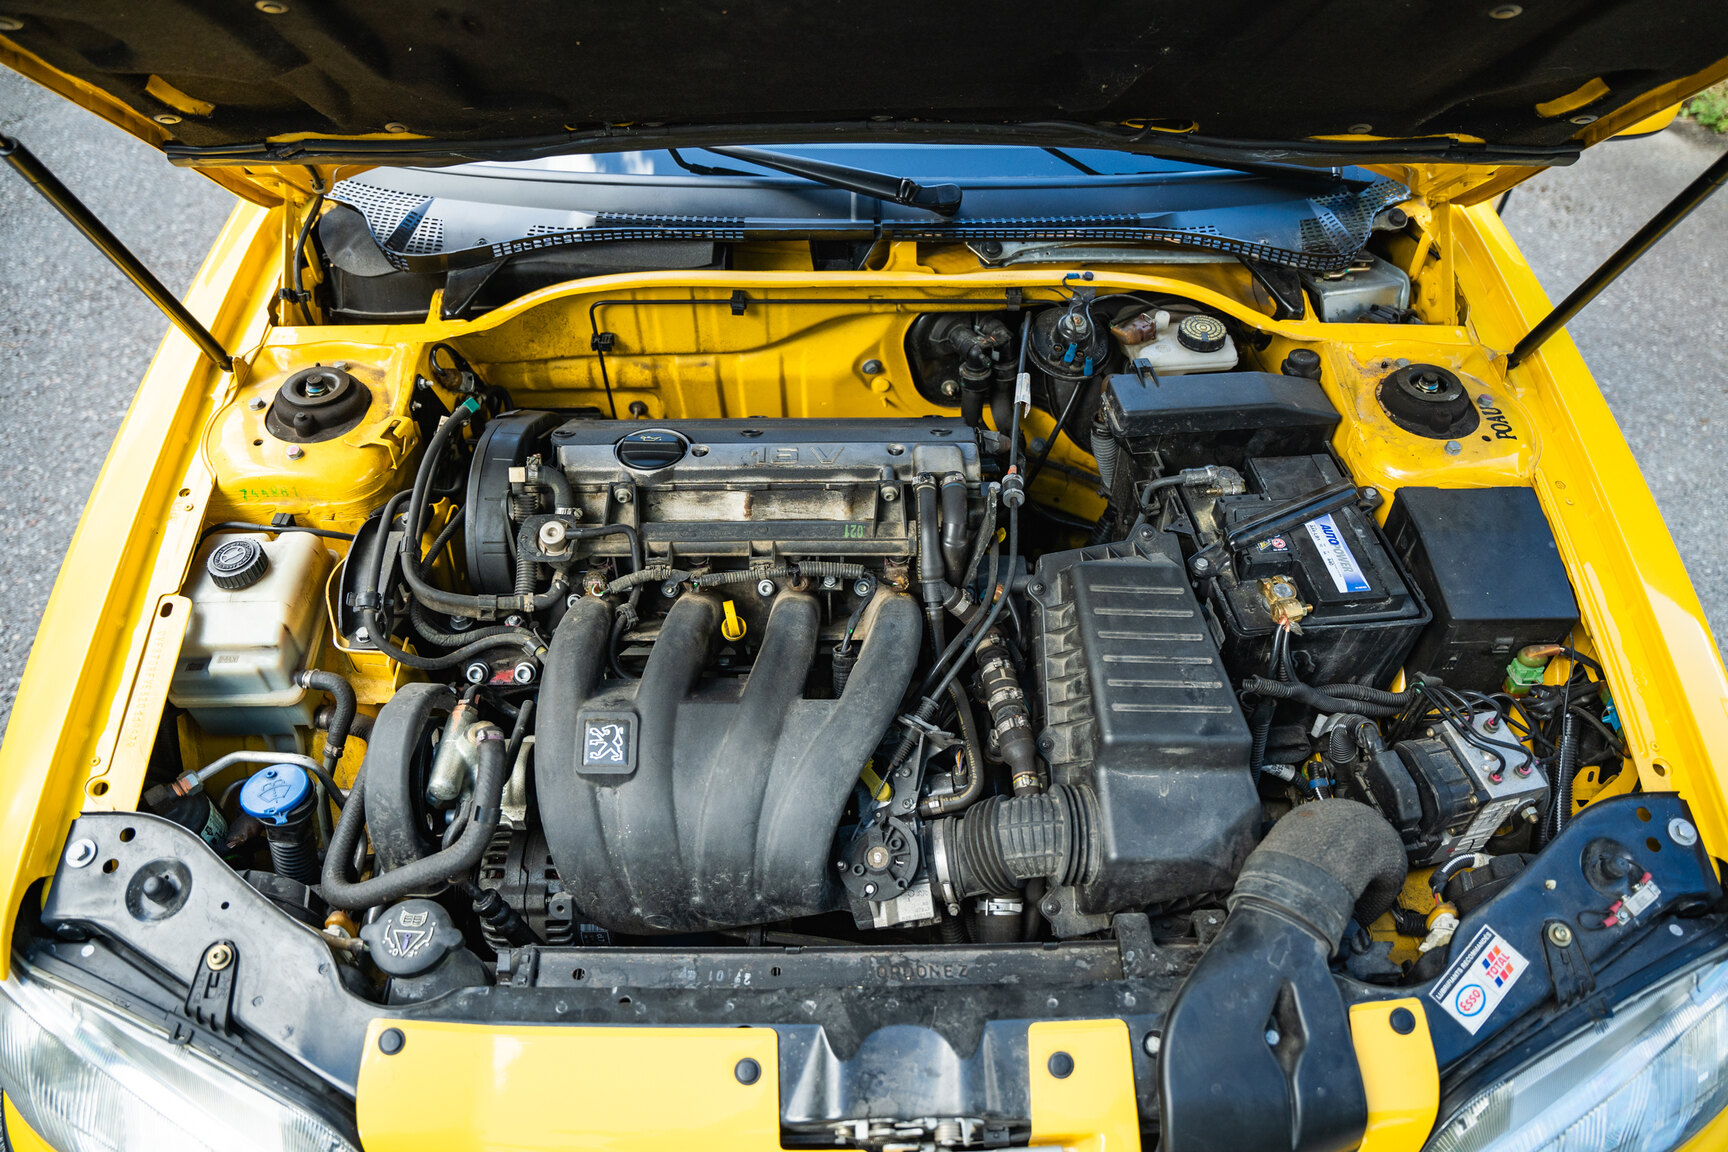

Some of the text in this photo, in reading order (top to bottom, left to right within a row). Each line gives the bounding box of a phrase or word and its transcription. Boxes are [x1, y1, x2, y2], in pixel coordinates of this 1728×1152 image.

[809, 446, 846, 464] V
[1485, 952, 1511, 980] TOTAL
[1435, 967, 1464, 1000] LUBRIFIANTS
